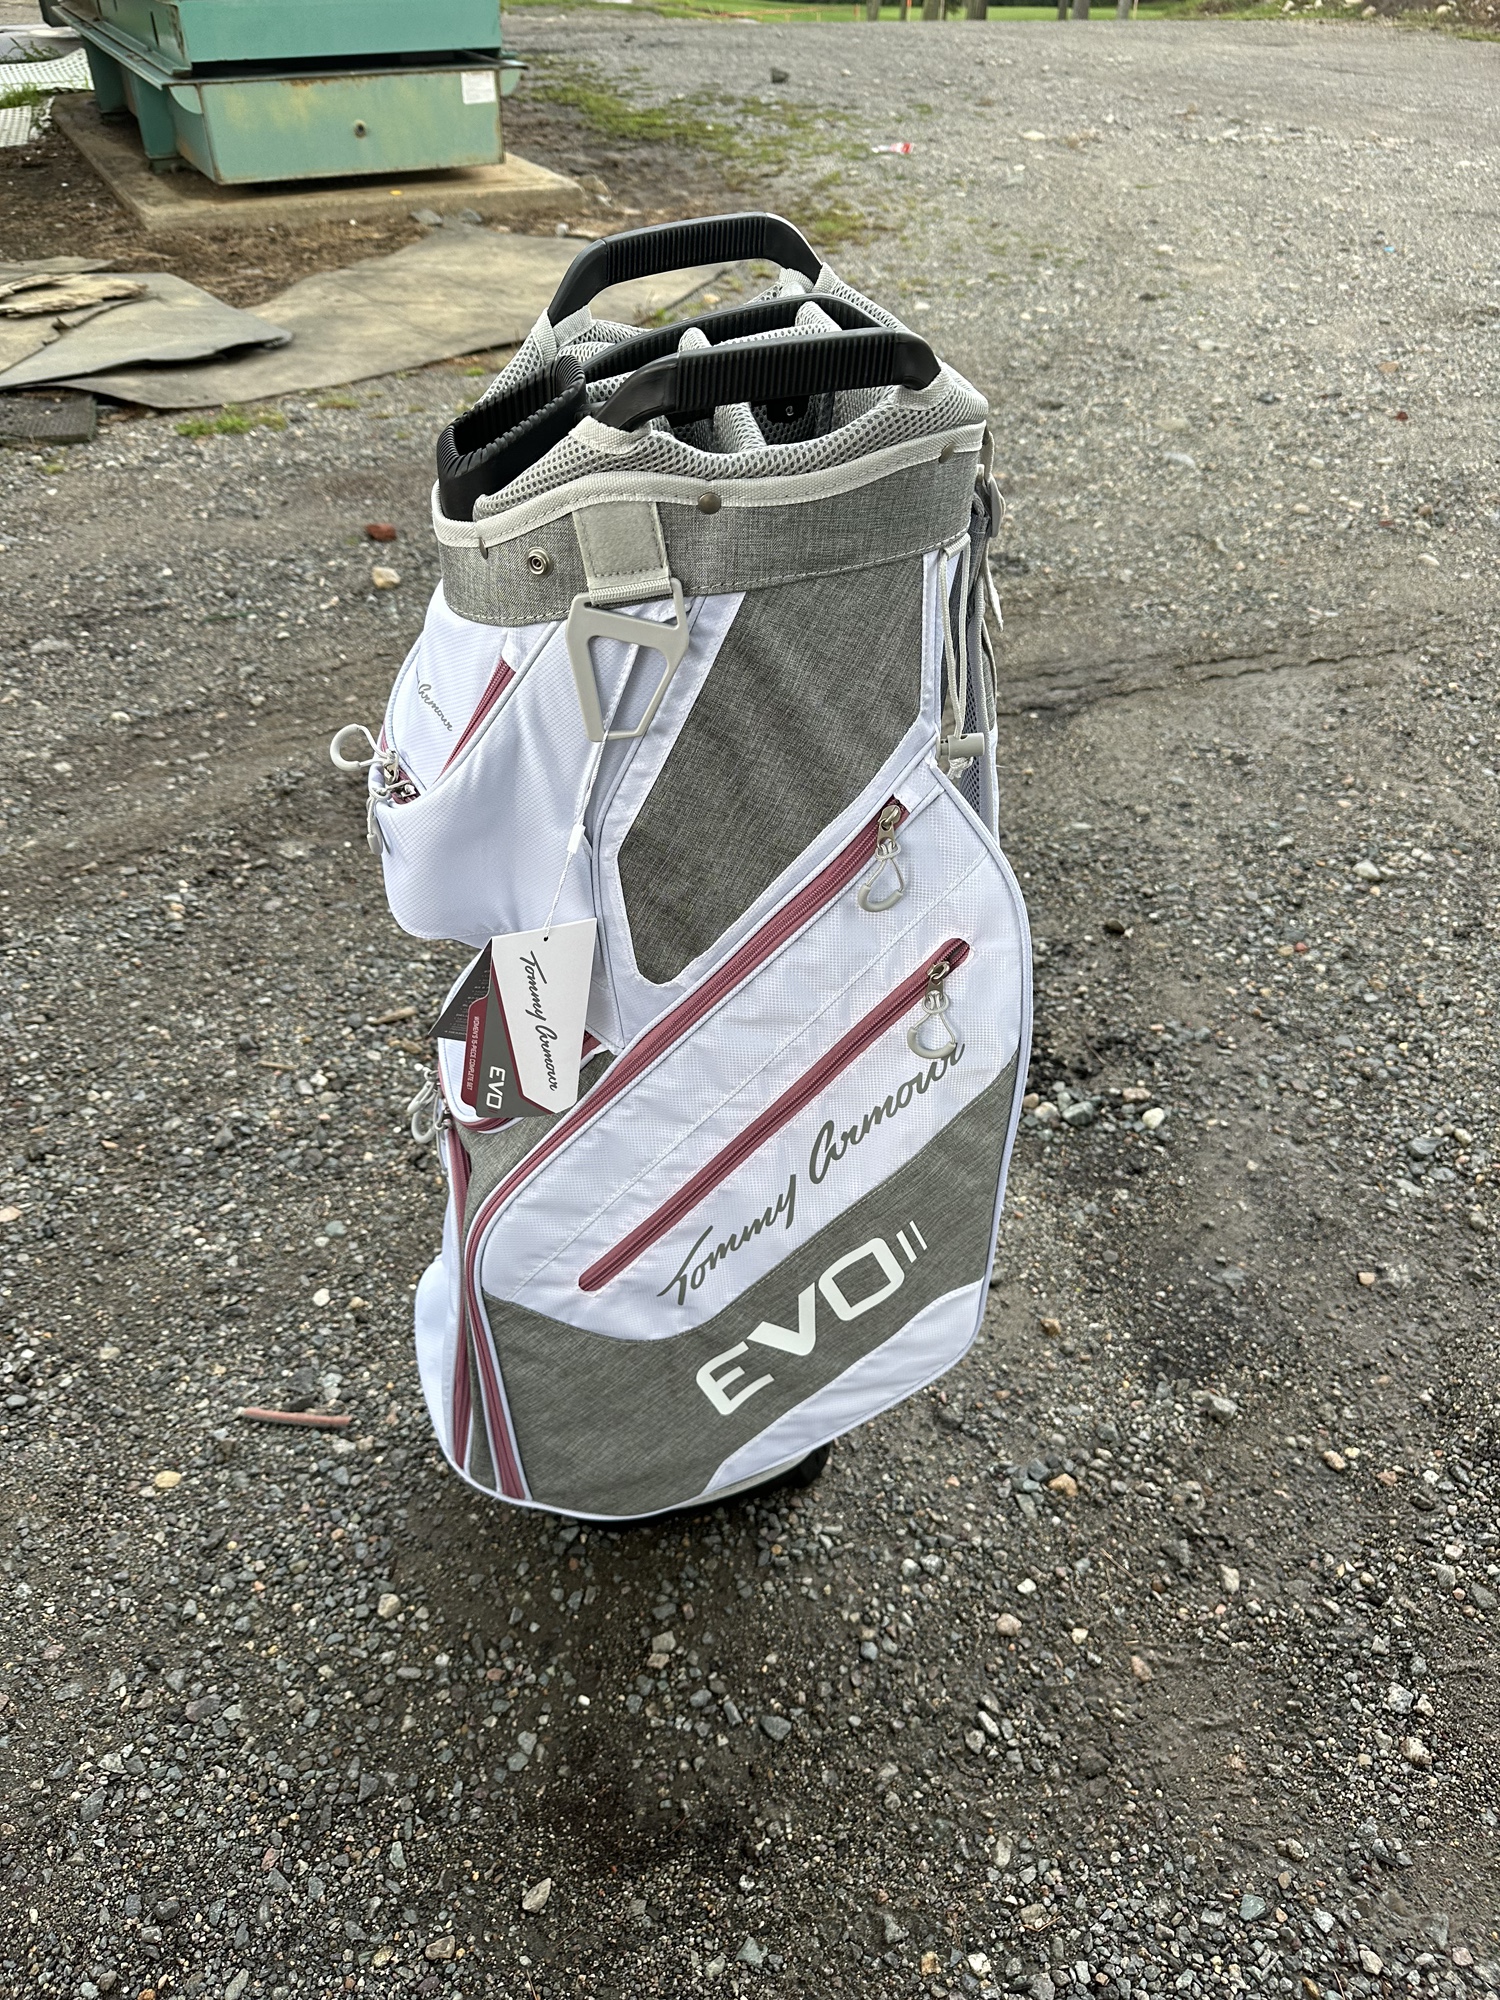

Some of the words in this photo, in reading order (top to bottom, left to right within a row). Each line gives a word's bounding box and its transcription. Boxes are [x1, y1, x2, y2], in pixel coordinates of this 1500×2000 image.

[486, 1065, 506, 1109] EVO
[519, 950, 548, 1021] Tommy
[535, 1024, 558, 1091] Armour
[657, 1174, 797, 1305] Tommy
[809, 1043, 965, 1184] Armour
[696, 1237, 905, 1415] EVO
